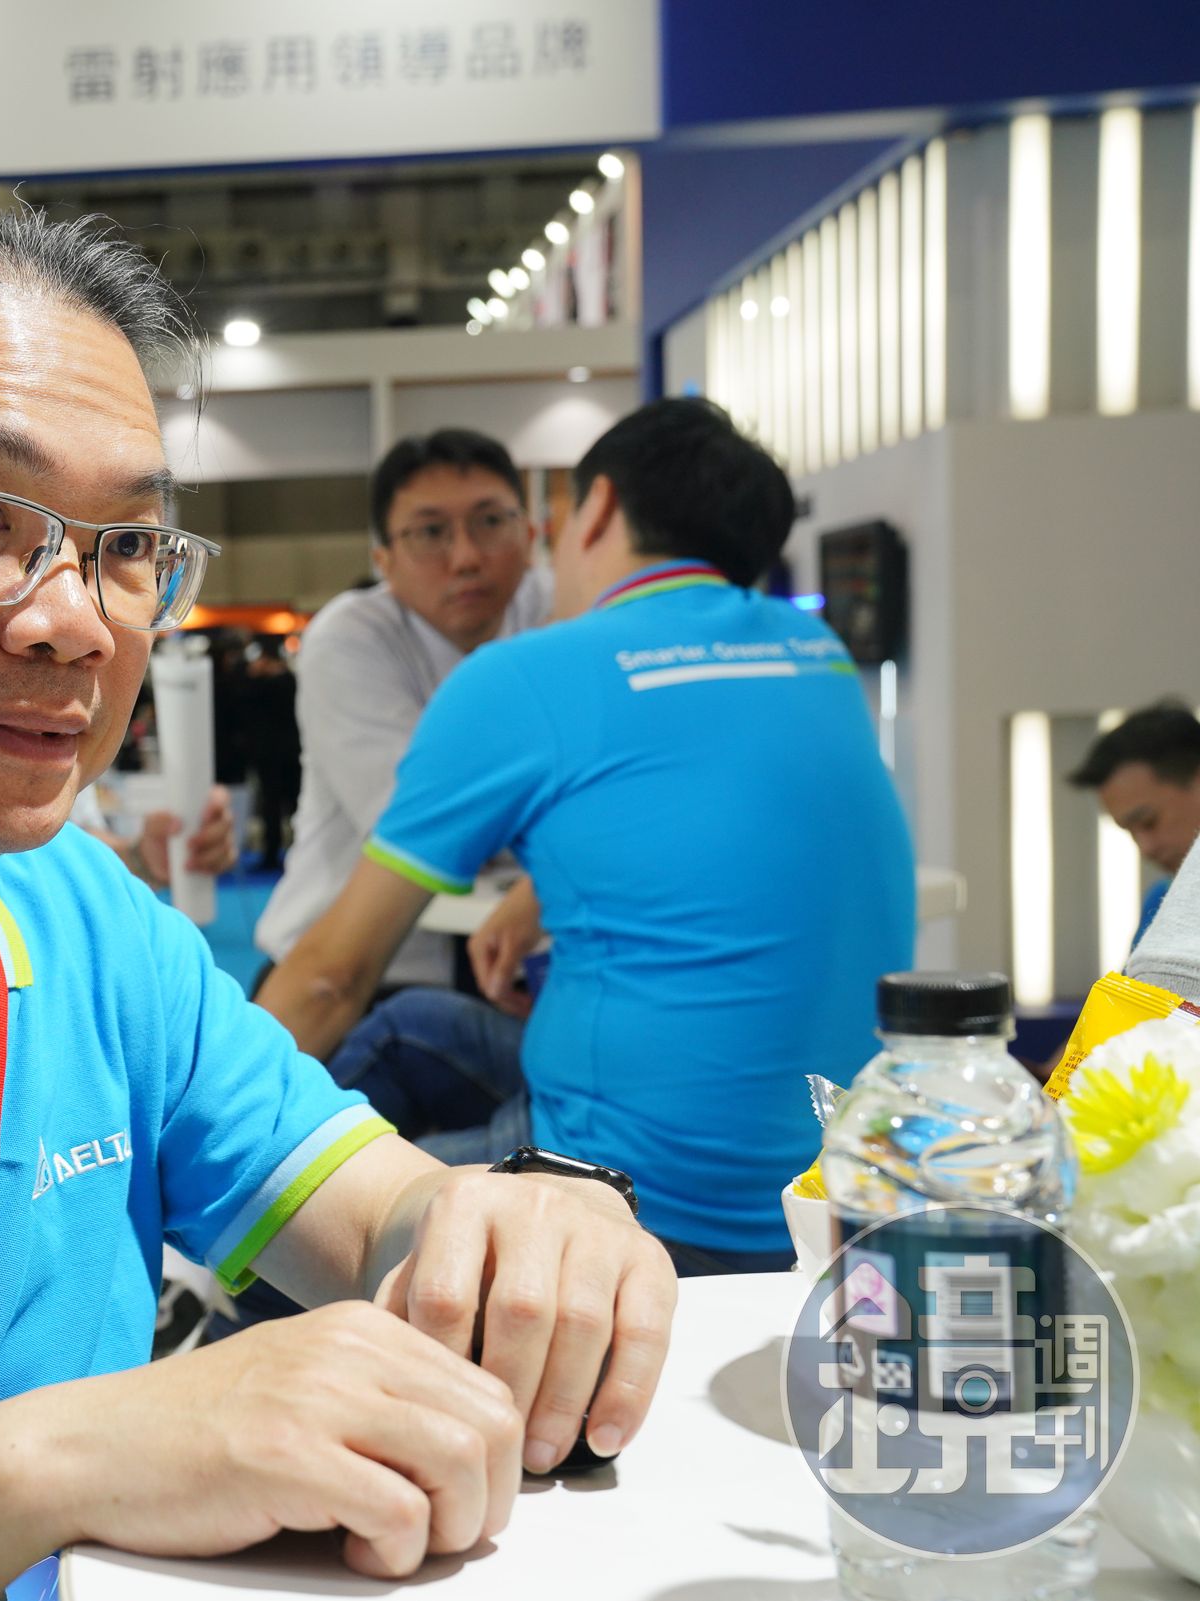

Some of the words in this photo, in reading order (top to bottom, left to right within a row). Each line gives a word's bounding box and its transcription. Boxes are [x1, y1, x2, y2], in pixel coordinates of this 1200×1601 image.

[65, 18, 590, 103] 雷射應用領導品牌
